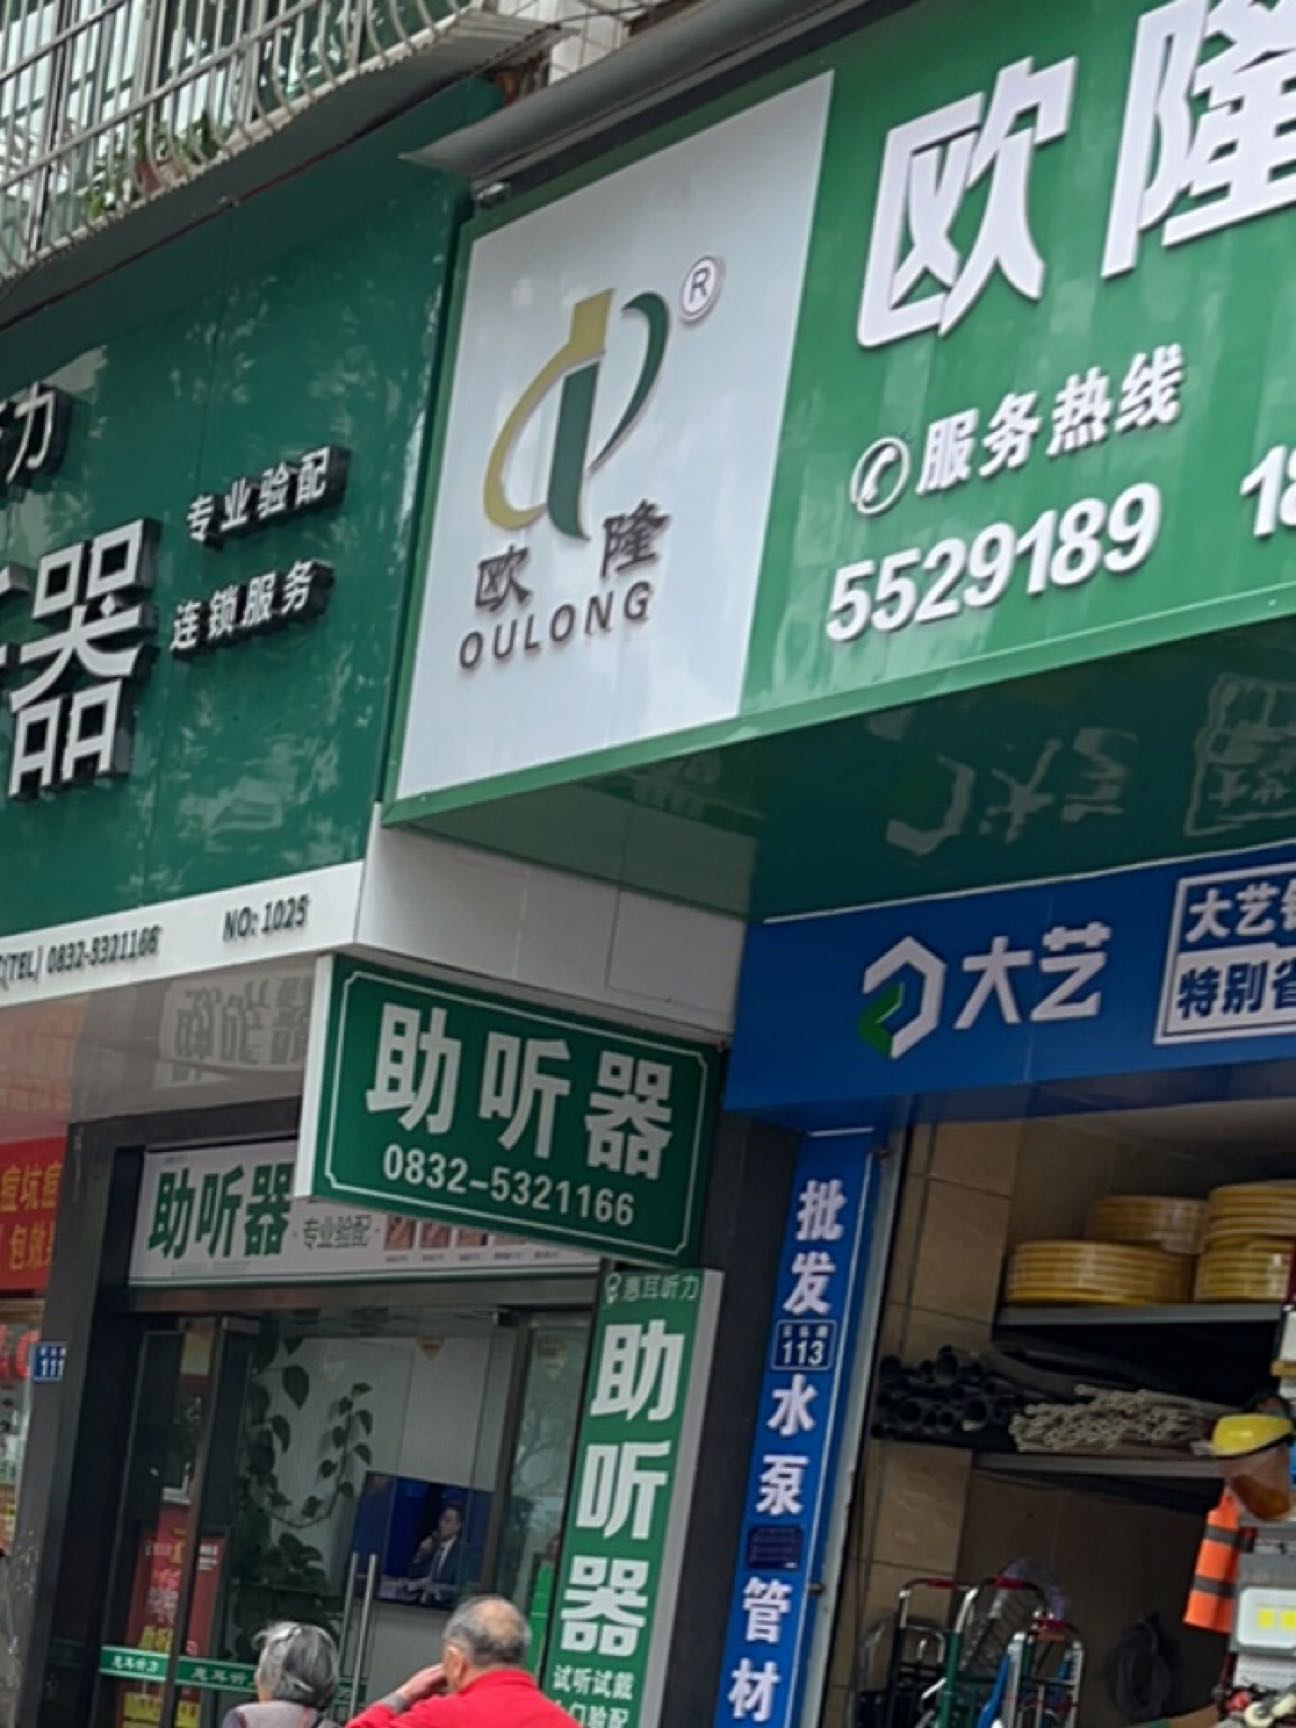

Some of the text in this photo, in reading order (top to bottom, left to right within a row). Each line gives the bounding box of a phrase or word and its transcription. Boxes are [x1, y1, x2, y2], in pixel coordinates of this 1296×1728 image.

[913, 344, 1186, 496] 服务热线
[185, 448, 332, 542] 专业验配
[170, 560, 318, 652] 连锁服务
[824, 482, 1162, 642] 5529189
[458, 586, 653, 672] OULONG
[223, 906, 258, 943] NO:
[954, 923, 1112, 1031] 大艺
[366, 1003, 673, 1181] 助听器
[149, 1163, 295, 1260] 助听器
[383, 1143, 635, 1227] 0832-5321166
[782, 1340, 825, 1366] 113
[560, 1317, 684, 1657] 助听器
